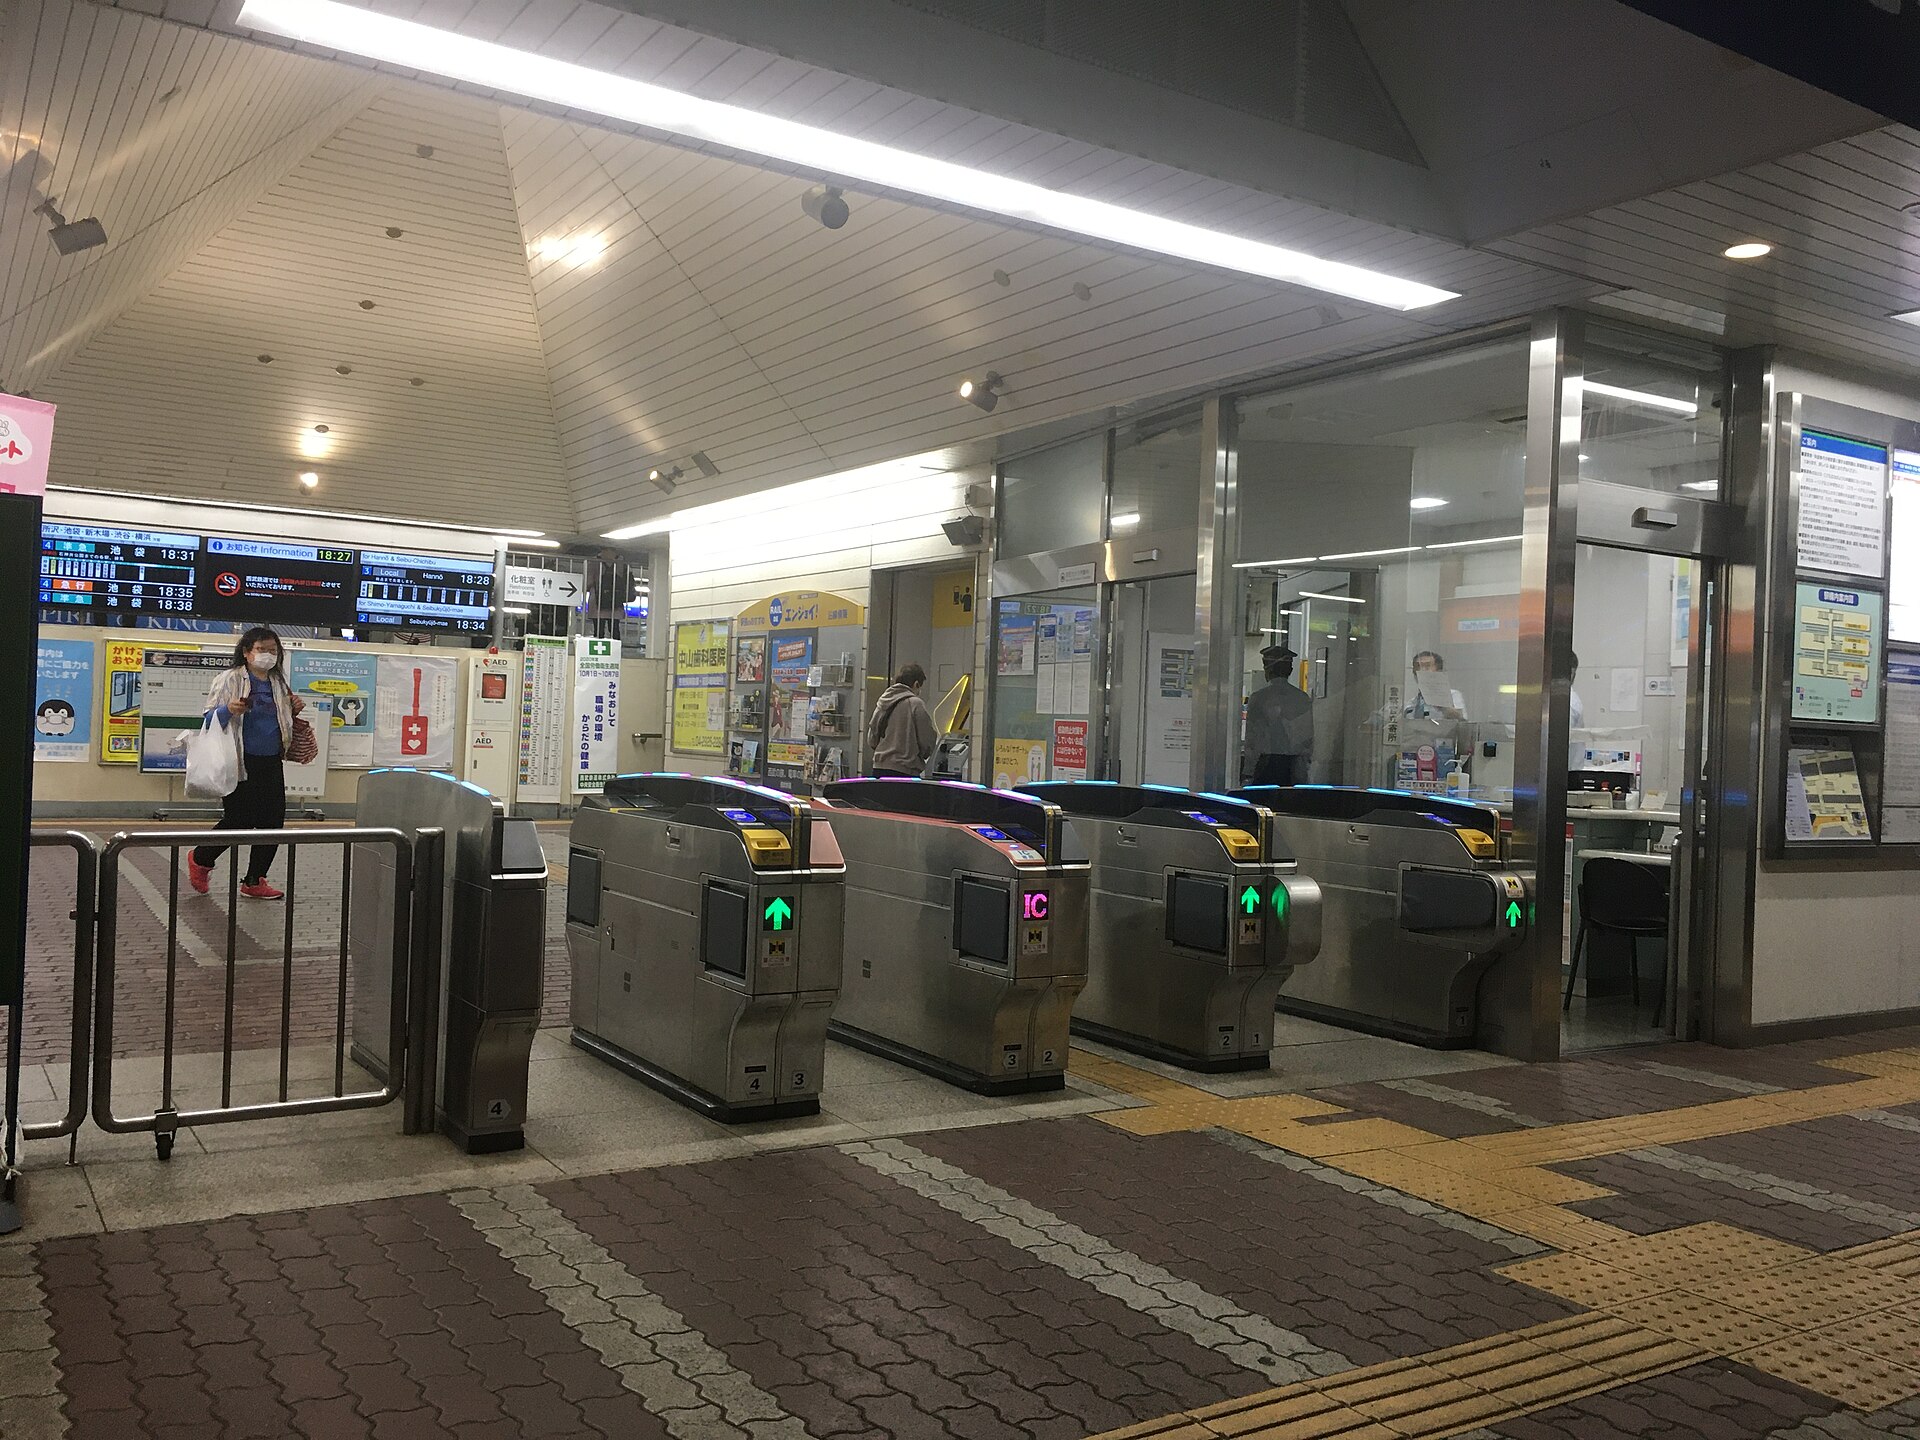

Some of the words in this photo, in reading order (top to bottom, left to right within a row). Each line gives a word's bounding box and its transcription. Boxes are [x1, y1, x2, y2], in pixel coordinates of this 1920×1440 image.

[44, 540, 50, 549] 4
[63, 541, 88, 552] 準急
[110, 544, 145, 558] 池袋
[161, 549, 195, 561] 18:31
[226, 543, 258, 553] お知らせ
[260, 546, 314, 558] Information
[319, 550, 351, 562] 18:27
[396, 556, 437, 565] Seibu-Chichibu
[364, 567, 370, 575] 3
[380, 568, 399, 577] Local
[461, 574, 490, 585] 18:28
[511, 574, 536, 585] 化粧室
[42, 579, 49, 588] 4
[60, 580, 86, 590] 急行
[107, 583, 143, 595] 池袋
[159, 586, 193, 598] 18:35
[42, 593, 49, 601] 4
[60, 594, 85, 603] 準急
[106, 596, 142, 608] 池袋
[158, 599, 193, 611] 18:38
[367, 601, 415, 611] Shimo-Yamaguchi
[147, 616, 210, 632] KING
[376, 615, 395, 623] Local
[456, 620, 485, 630] 18:34
[678, 648, 727, 669] 中山歯科医院
[608, 681, 617, 727] みなおして
[593, 695, 604, 742] 職場の環境
[580, 714, 590, 770] からだの健康
[1023, 894, 1048, 919] IC
[1222, 1034, 1231, 1047] 2
[1253, 1033, 1260, 1046] 1
[1008, 1054, 1017, 1066] 3
[1044, 1050, 1053, 1062] 2
[749, 1078, 761, 1091] 4
[794, 1072, 805, 1086] 3
[490, 1102, 503, 1117] 4
